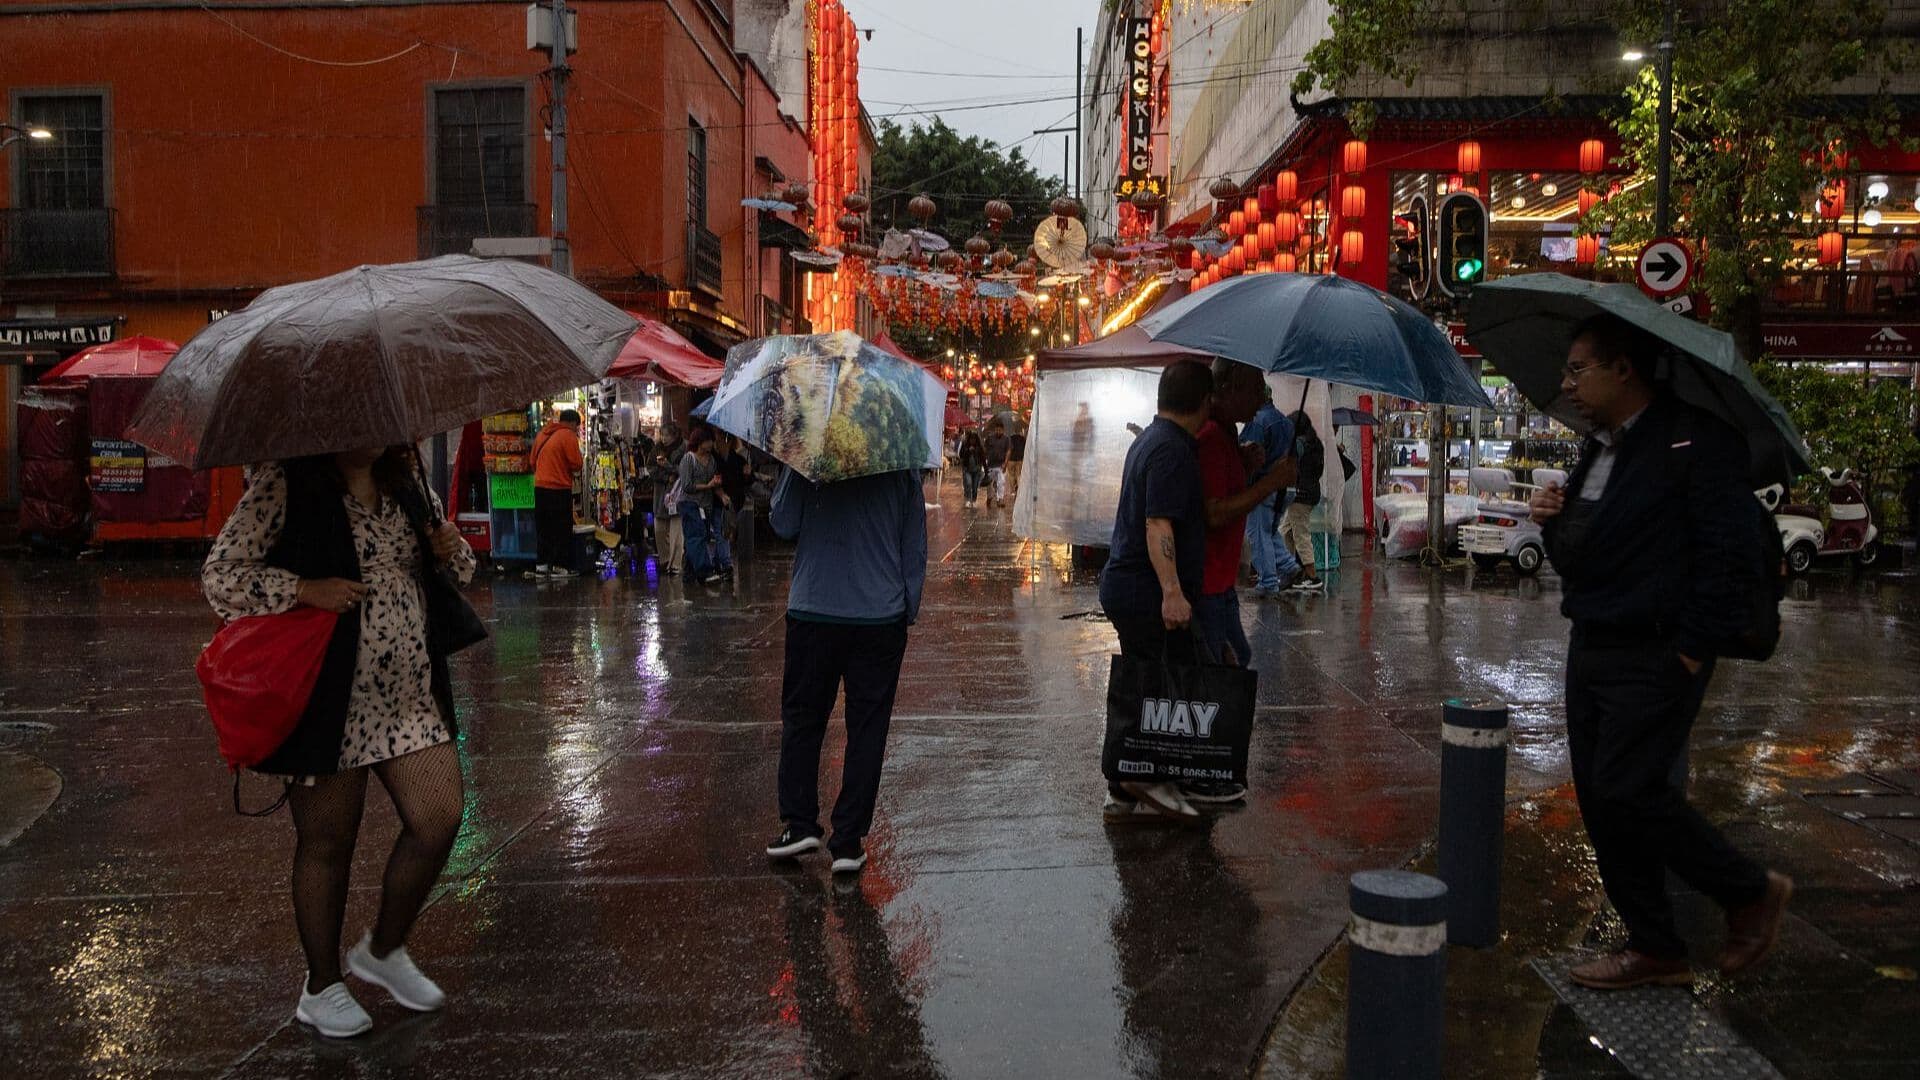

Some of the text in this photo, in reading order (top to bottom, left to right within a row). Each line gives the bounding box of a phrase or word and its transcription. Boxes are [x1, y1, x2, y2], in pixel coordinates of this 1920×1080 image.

[1132, 23, 1150, 171] HONG KING
[1763, 335, 1799, 347] HINA
[1141, 698, 1220, 738] MAY
